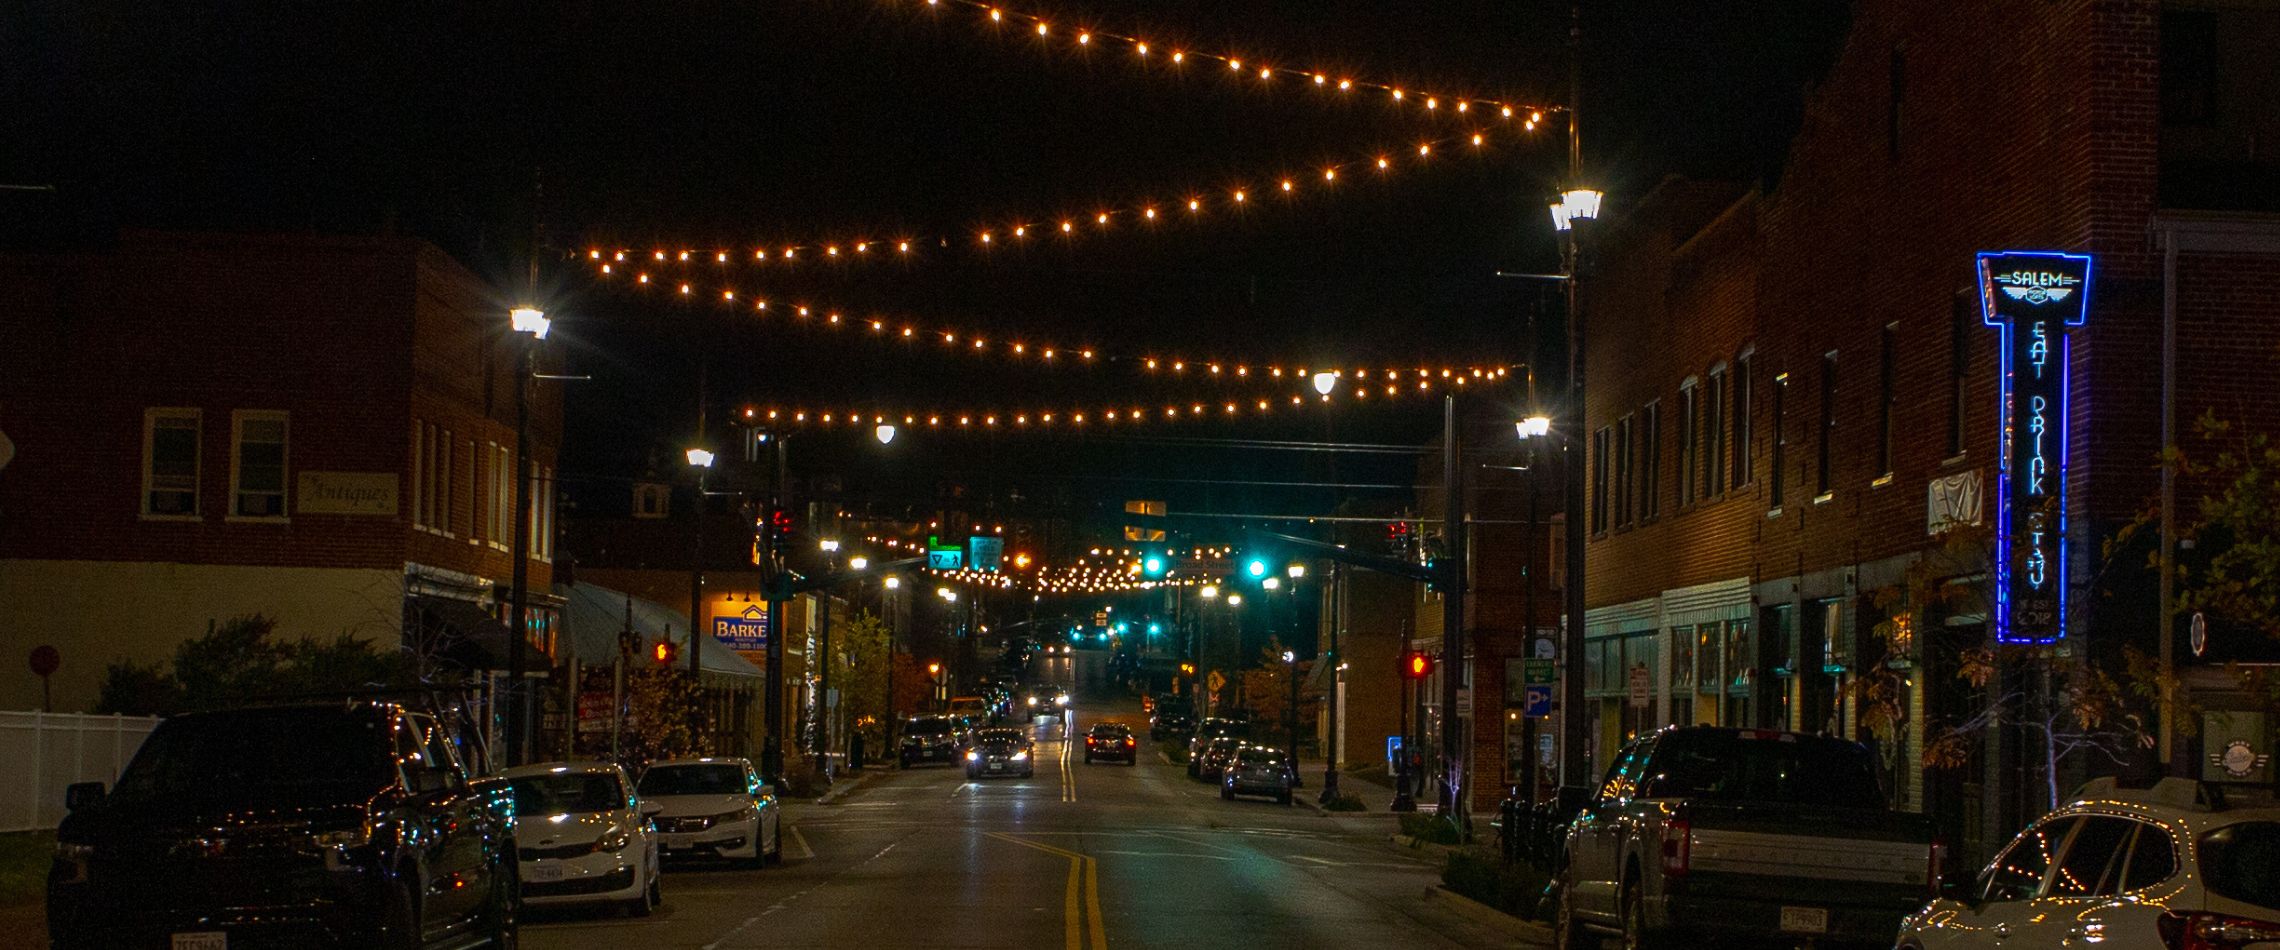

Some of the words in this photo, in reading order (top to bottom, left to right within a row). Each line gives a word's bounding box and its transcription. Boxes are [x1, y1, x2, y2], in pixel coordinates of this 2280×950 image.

[2011, 271, 2062, 287] SALEM
[2029, 320, 2048, 379] EAT
[2030, 395, 2046, 495] DRINK
[309, 482, 390, 507] Antiques
[1527, 690, 1542, 713] P
